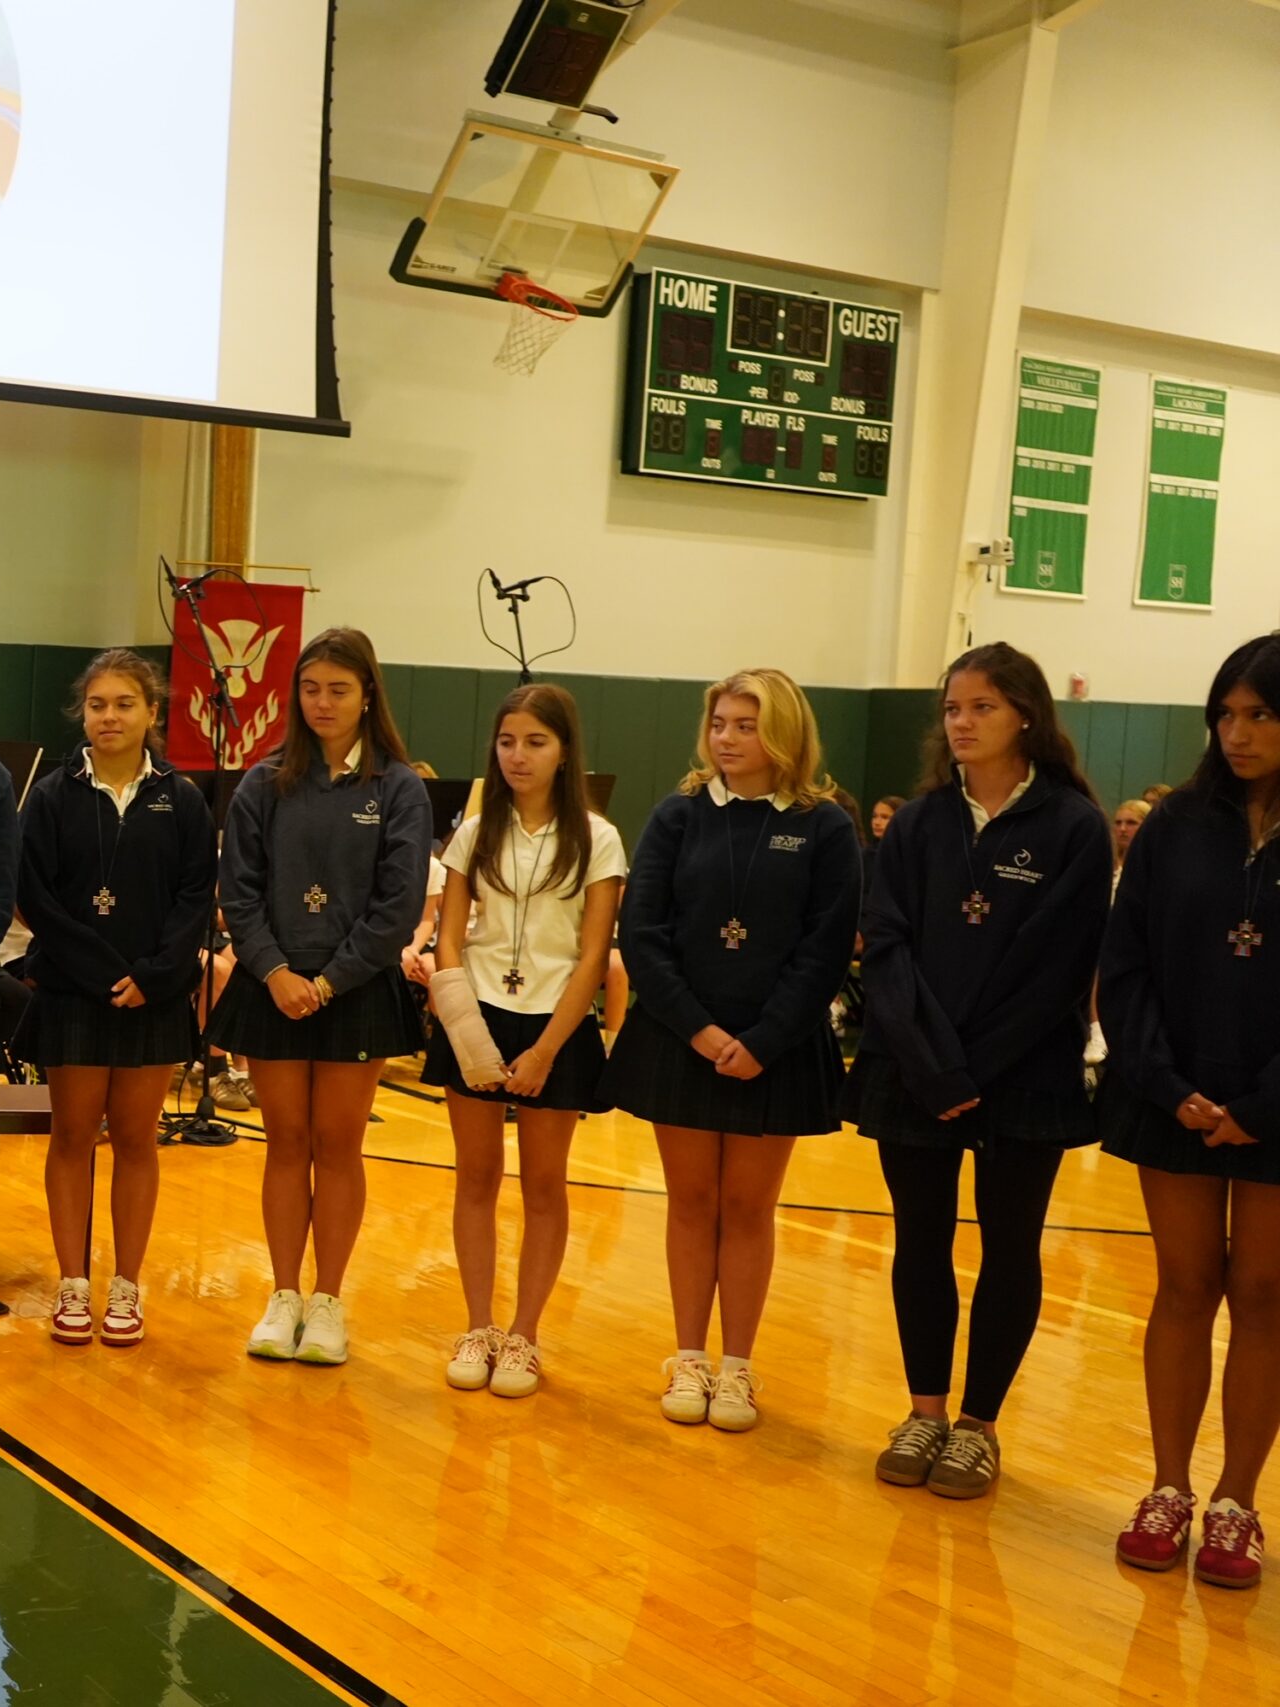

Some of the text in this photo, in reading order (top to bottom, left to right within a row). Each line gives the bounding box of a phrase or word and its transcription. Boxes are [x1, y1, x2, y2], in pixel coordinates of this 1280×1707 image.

[659, 276, 718, 313] HOME
[839, 307, 899, 343] GUEST
[738, 360, 762, 375] POSS
[793, 368, 816, 383] POSS
[680, 374, 718, 394] BONUS
[650, 397, 686, 416] FOULS
[830, 396, 866, 415] BONUS
[740, 409, 806, 432] PLAYER FLS
[856, 425, 889, 442] FOULS
